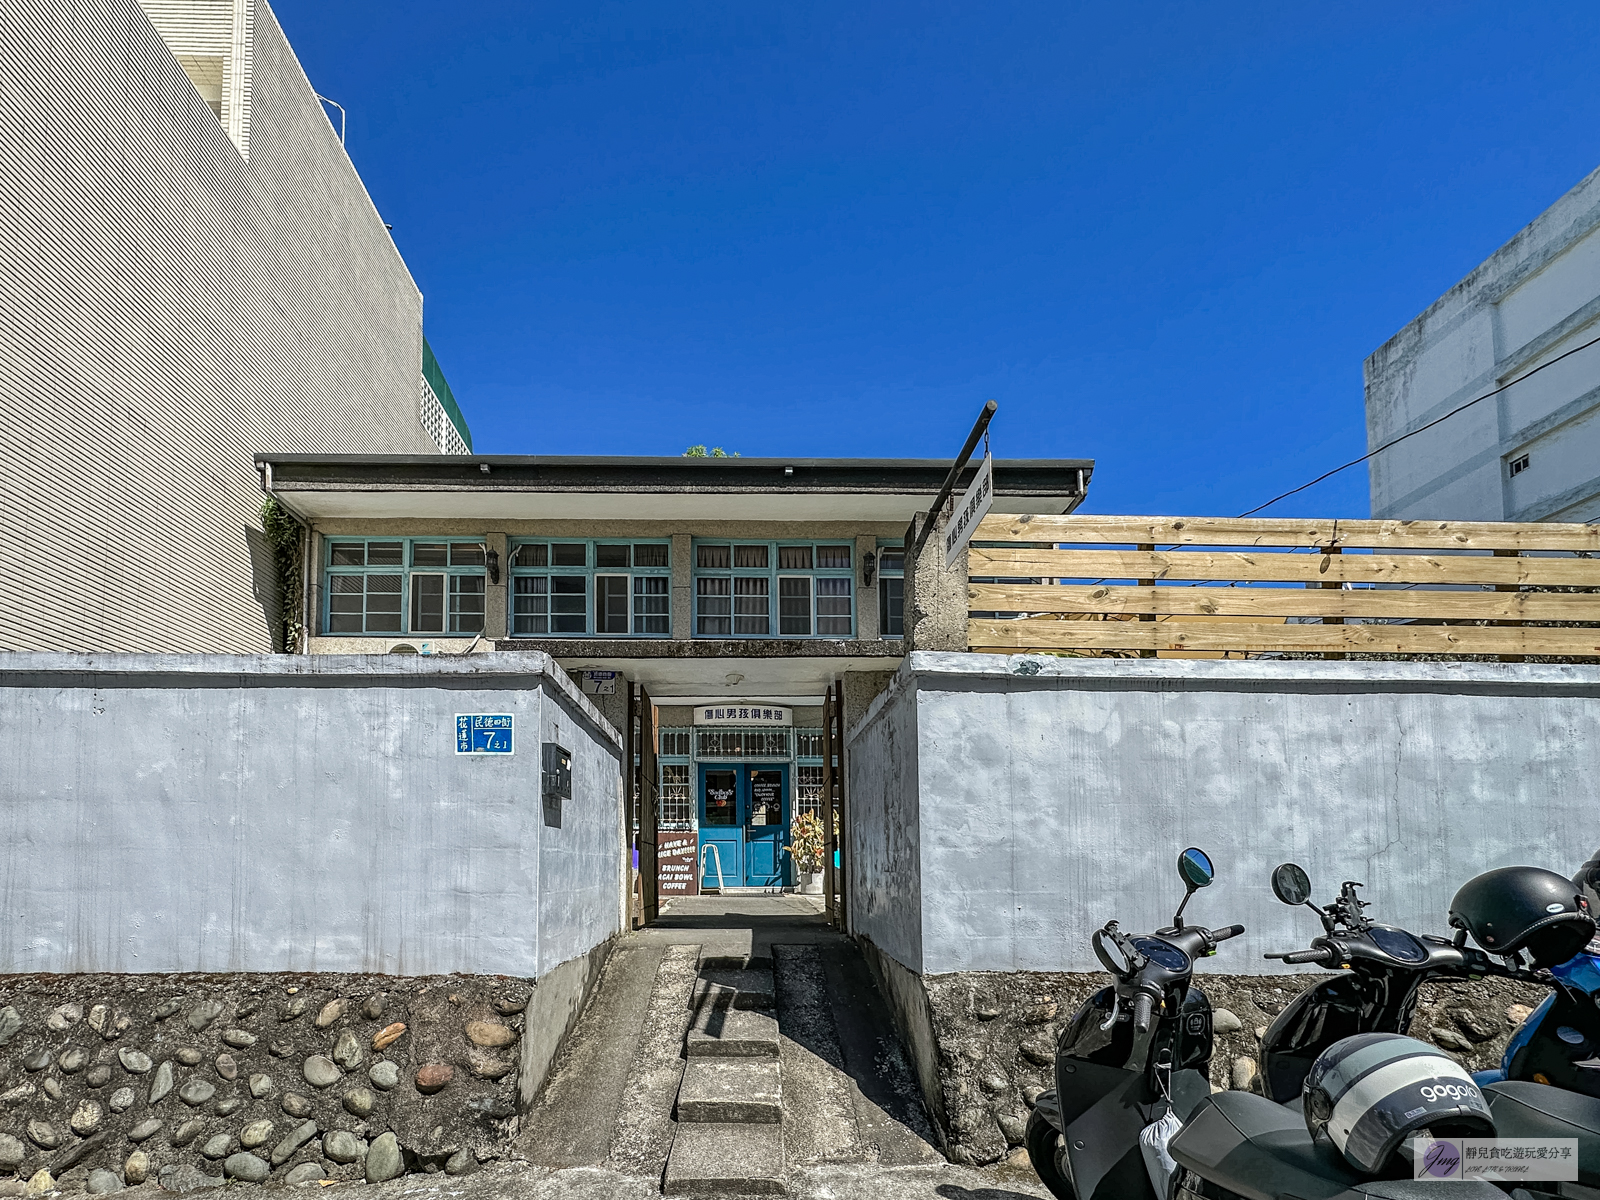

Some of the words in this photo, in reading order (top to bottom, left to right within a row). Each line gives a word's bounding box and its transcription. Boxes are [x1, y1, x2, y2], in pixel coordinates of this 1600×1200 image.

[474, 716, 512, 728] 民德四街
[458, 716, 469, 752] 花蓮市
[483, 731, 508, 749] 7之1
[664, 840, 682, 849] HAVE
[661, 864, 690, 872] BRUNCH
[657, 873, 674, 881] ACAI
[674, 873, 694, 881] BOWL
[662, 882, 687, 890] COFFEE
